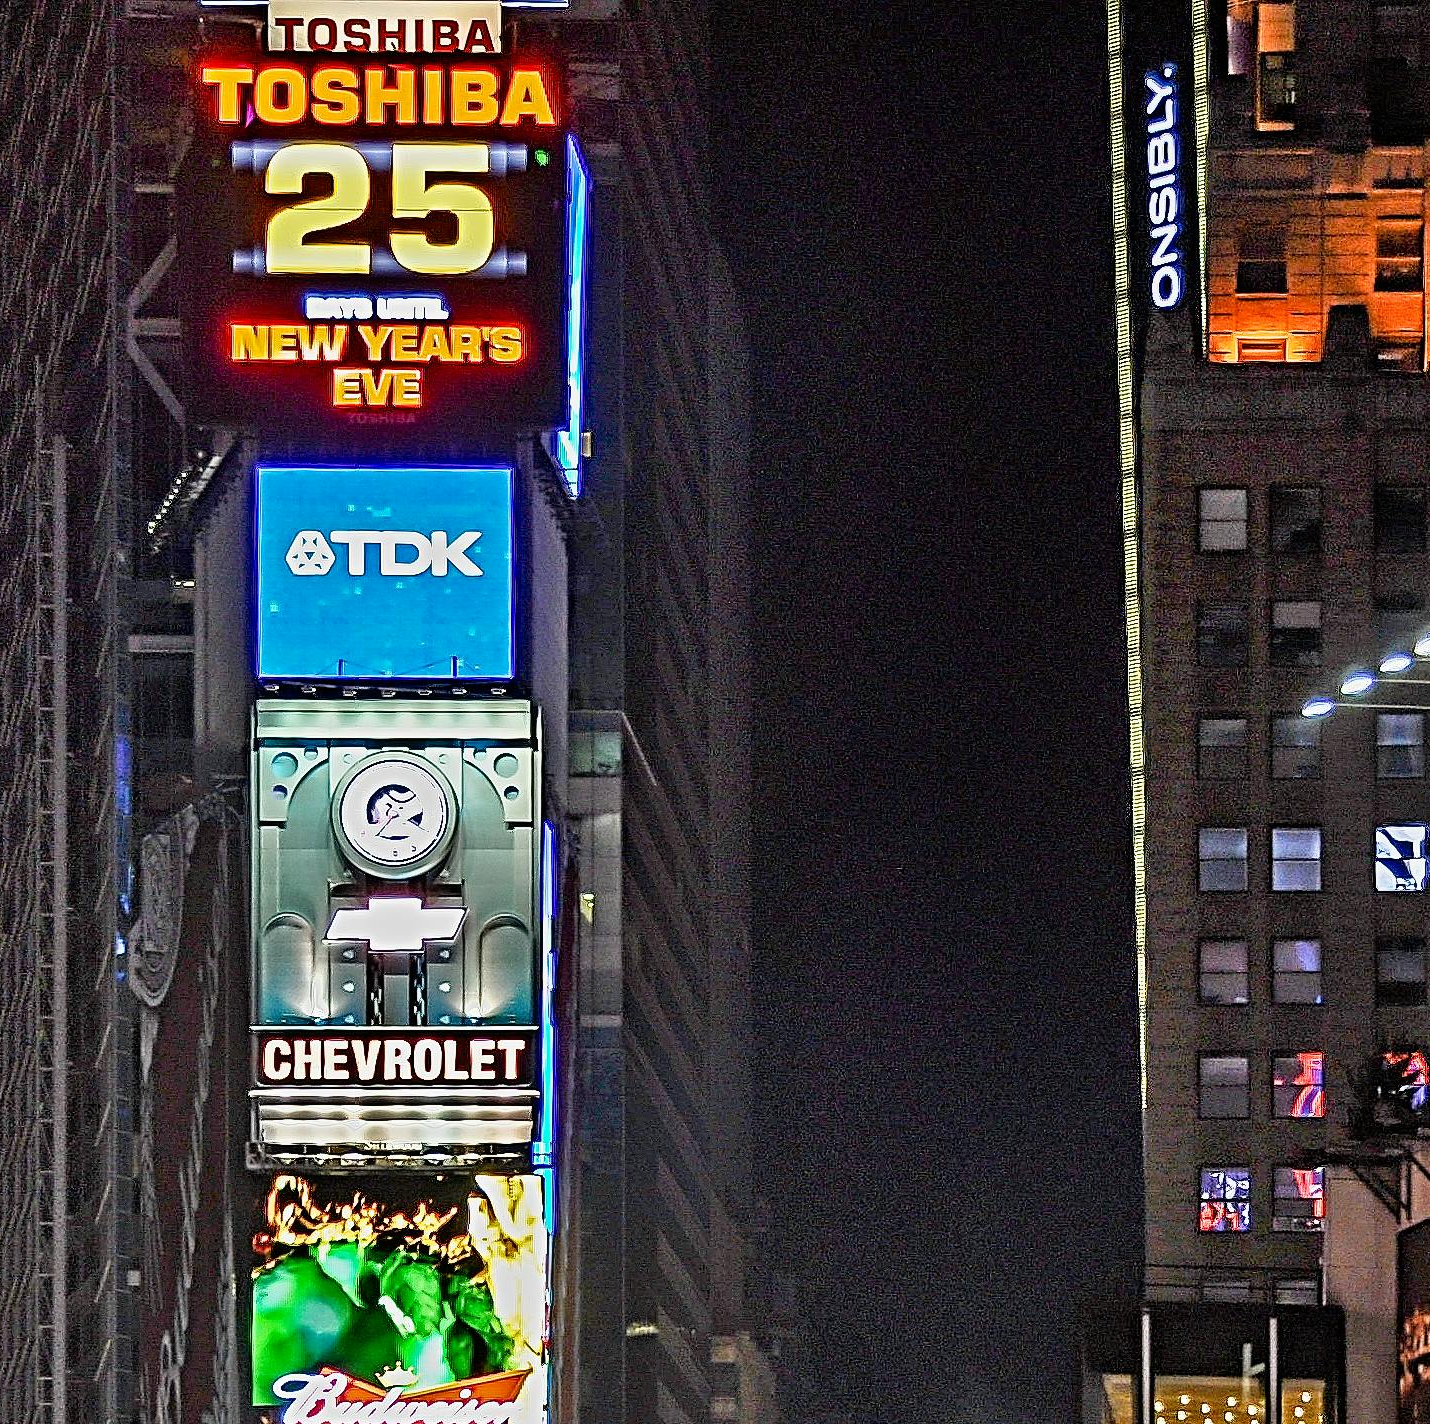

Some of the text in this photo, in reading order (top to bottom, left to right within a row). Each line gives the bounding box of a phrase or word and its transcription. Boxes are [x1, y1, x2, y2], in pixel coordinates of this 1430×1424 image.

[274, 17, 495, 53] TOSHIBA
[202, 67, 556, 126] TOSHIBA
[264, 143, 495, 275] 25
[231, 325, 523, 362] NEW YEAR'S
[333, 368, 423, 407] EVE
[329, 530, 484, 577] TDK
[263, 1039, 526, 1081] CHEVROLET
